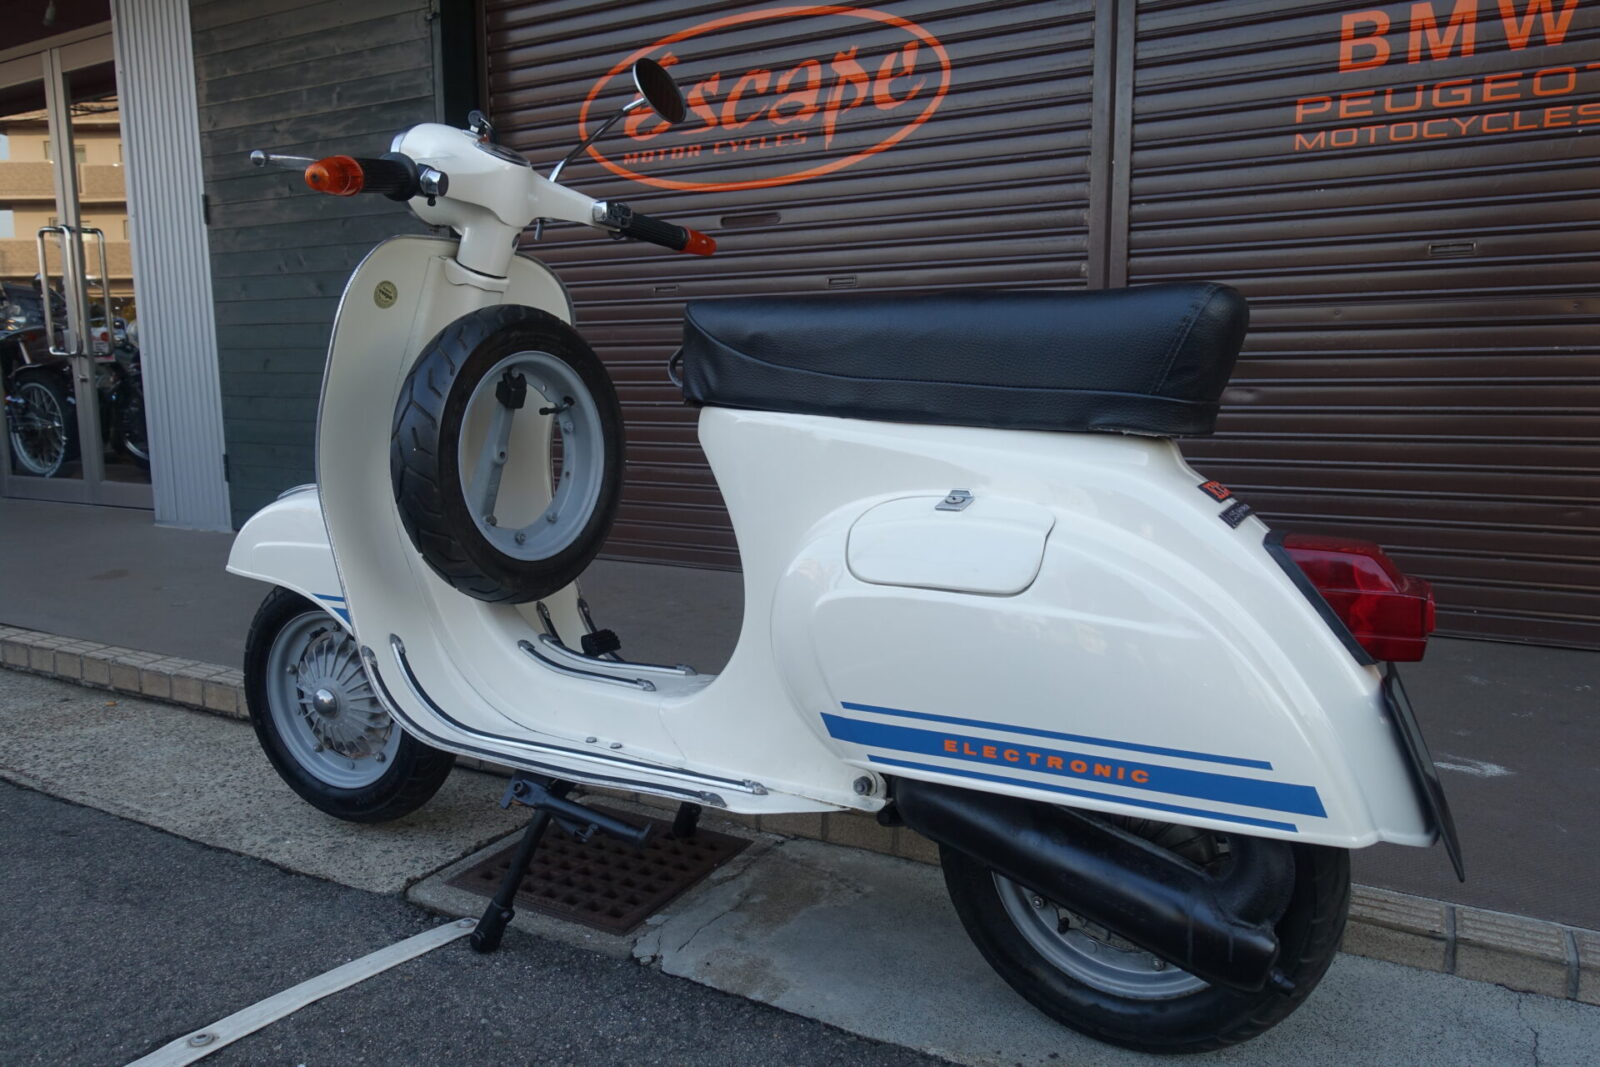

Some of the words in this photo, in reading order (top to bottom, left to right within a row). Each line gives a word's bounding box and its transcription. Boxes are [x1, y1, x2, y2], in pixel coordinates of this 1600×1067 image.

[1338, 0, 1580, 73] BMW
[623, 144, 701, 165] MOTOR
[713, 131, 808, 155] CYCLES
[1294, 102, 1600, 151] MOTOCYCLES
[943, 739, 1150, 784] ELECTRONIC
